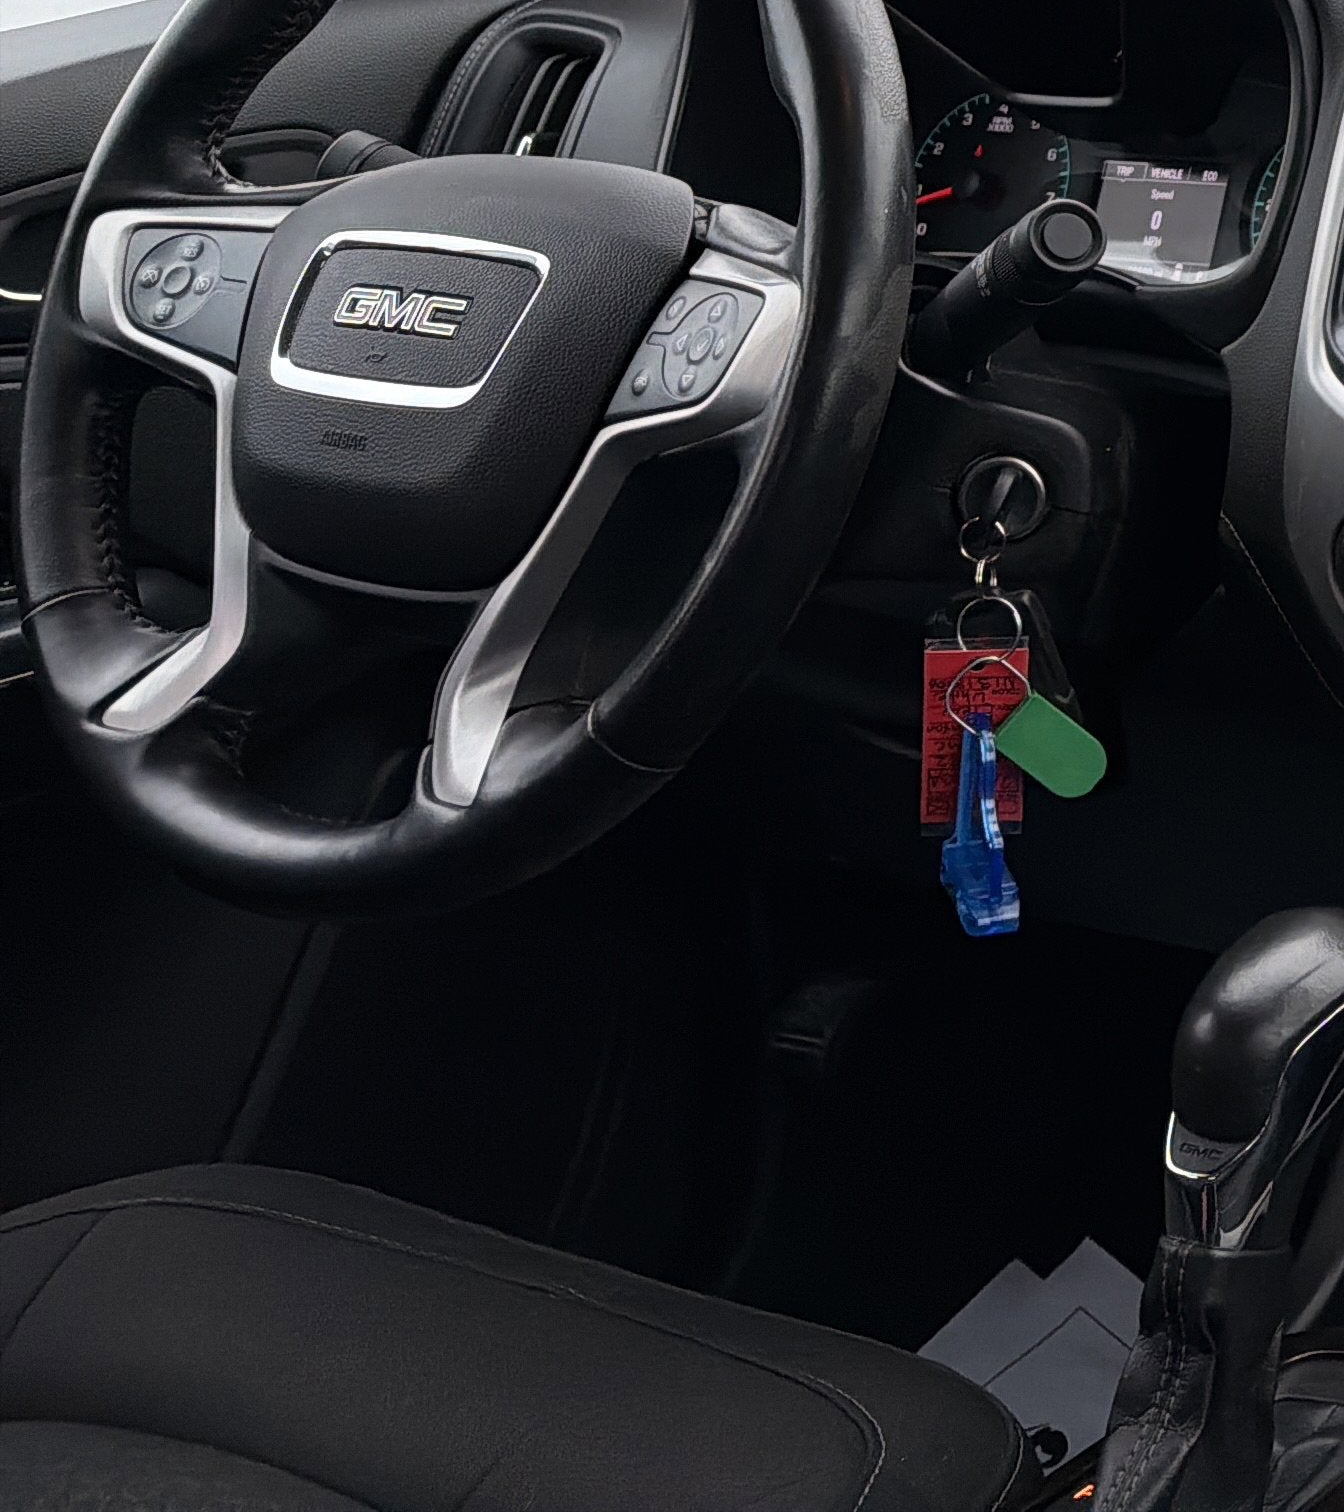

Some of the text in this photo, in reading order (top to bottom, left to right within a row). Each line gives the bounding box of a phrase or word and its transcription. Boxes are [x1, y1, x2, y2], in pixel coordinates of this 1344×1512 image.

[962, 113, 973, 126] 3
[933, 142, 945, 156] 2
[1047, 148, 1058, 162] 6
[1116, 165, 1219, 182] TRIP VEHICLE ECO
[1150, 210, 1163, 230] 0
[916, 222, 927, 236] 0
[332, 284, 473, 340] GMC
[1179, 1142, 1223, 1161] GMC
